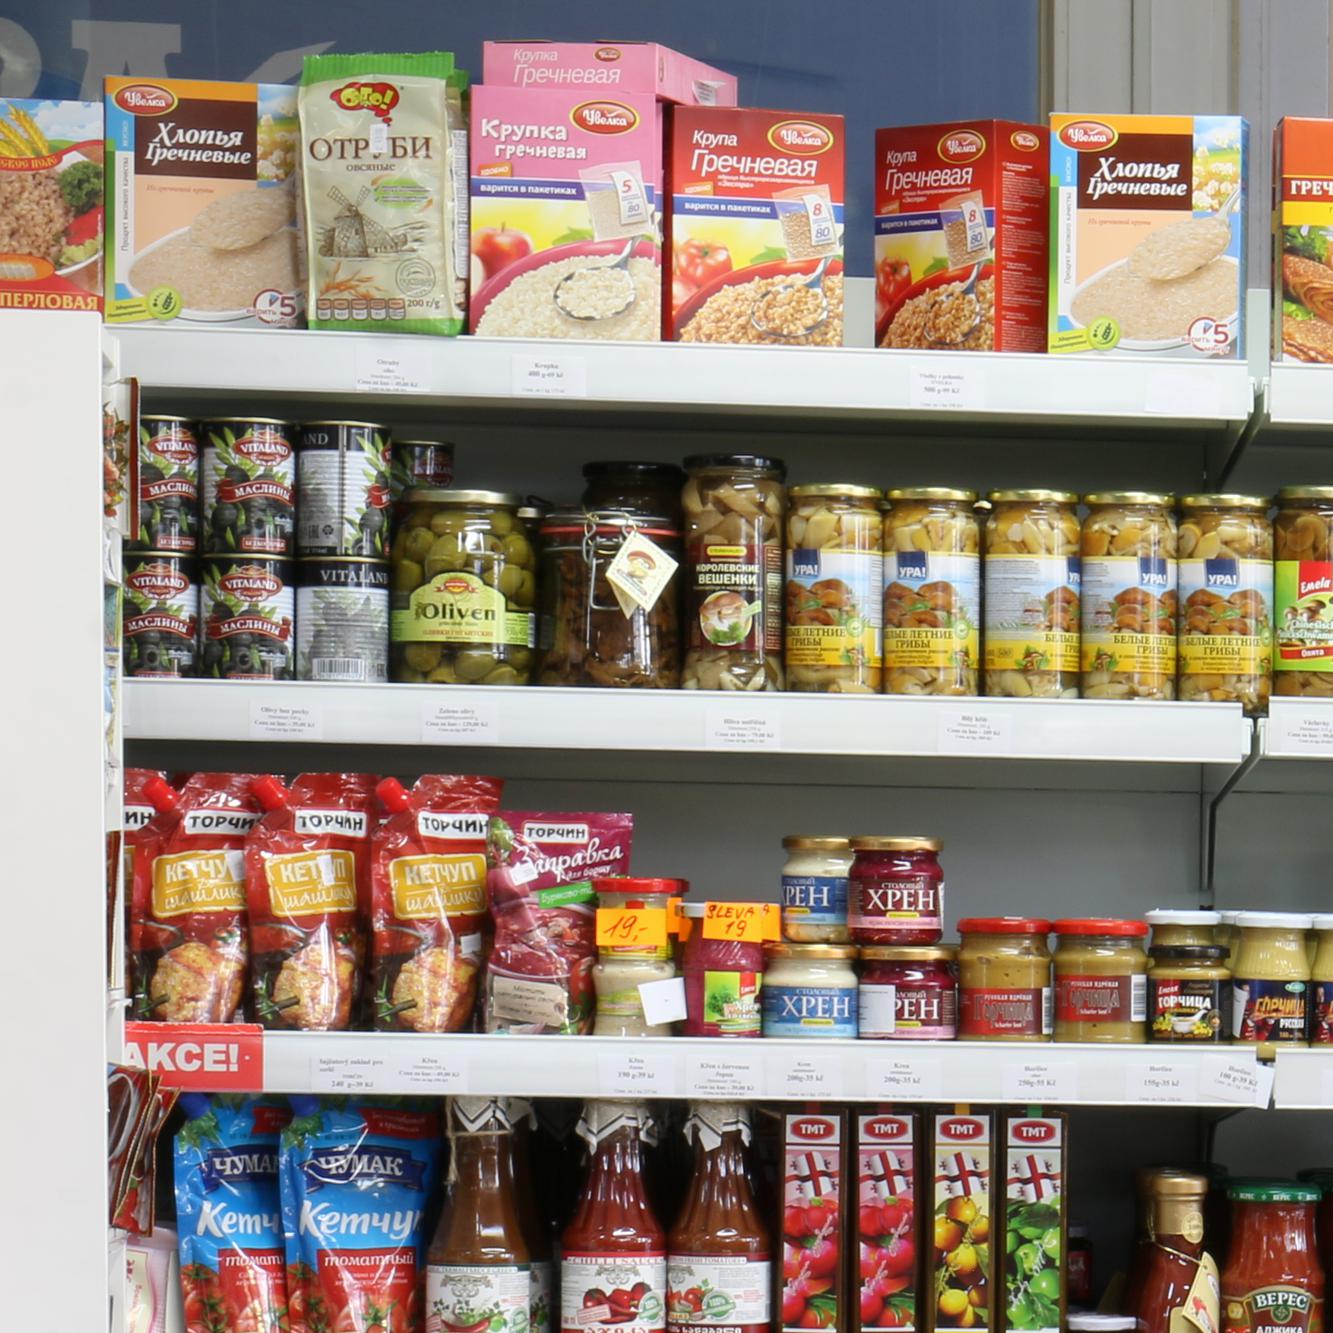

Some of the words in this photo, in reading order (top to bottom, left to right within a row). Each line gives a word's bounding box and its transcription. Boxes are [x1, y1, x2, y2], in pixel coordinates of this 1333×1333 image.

[513, 48, 558, 64] Крупка
[515, 65, 620, 85] Гречневая
[124, 92, 167, 108] Увелка
[582, 108, 629, 127] Увелка
[154, 123, 243, 147] Хлопья
[481, 118, 567, 143] Крупка
[692, 129, 738, 150] Крупа
[145, 143, 251, 166] Гречневые
[494, 141, 587, 162] гречневая
[886, 149, 917, 166] Крупа
[691, 147, 817, 178] Гречневая
[1097, 156, 1180, 180] Хлопья
[480, 183, 519, 193] варится
[527, 186, 577, 196] пакетиках
[1086, 176, 1187, 199] Гречневые
[813, 202, 822, 217] 8
[814, 225, 830, 240] 80
[0, 293, 98, 311] ПЕРЛОВАЯ
[406, 299, 425, 309] 200
[698, 572, 757, 584] ВЕШЕНКИ
[794, 564, 819, 576] УРА!
[132, 575, 186, 592] VITALAND
[224, 576, 280, 591] VITALAND
[1300, 578, 1331, 593] Emela
[421, 601, 497, 624] Oliven
[127, 618, 194, 634] МАСЛИНЫ
[298, 813, 363, 831] ТОРЧИН
[422, 816, 489, 834] ТОРЧИН
[405, 862, 476, 883] КЕТЧУП
[866, 889, 934, 912] ХРЕН
[706, 904, 755, 919] SLEVA
[724, 920, 747, 937] 19
[782, 996, 850, 1017] ХРЕН
[1158, 996, 1211, 1009] ГОРЧИЦА
[122, 1041, 240, 1071] AKCE!
[318, 1154, 404, 1177] ЧУМАК
[324, 1252, 414, 1267] томатный
[1255, 1291, 1308, 1311] ВЕРЕС
